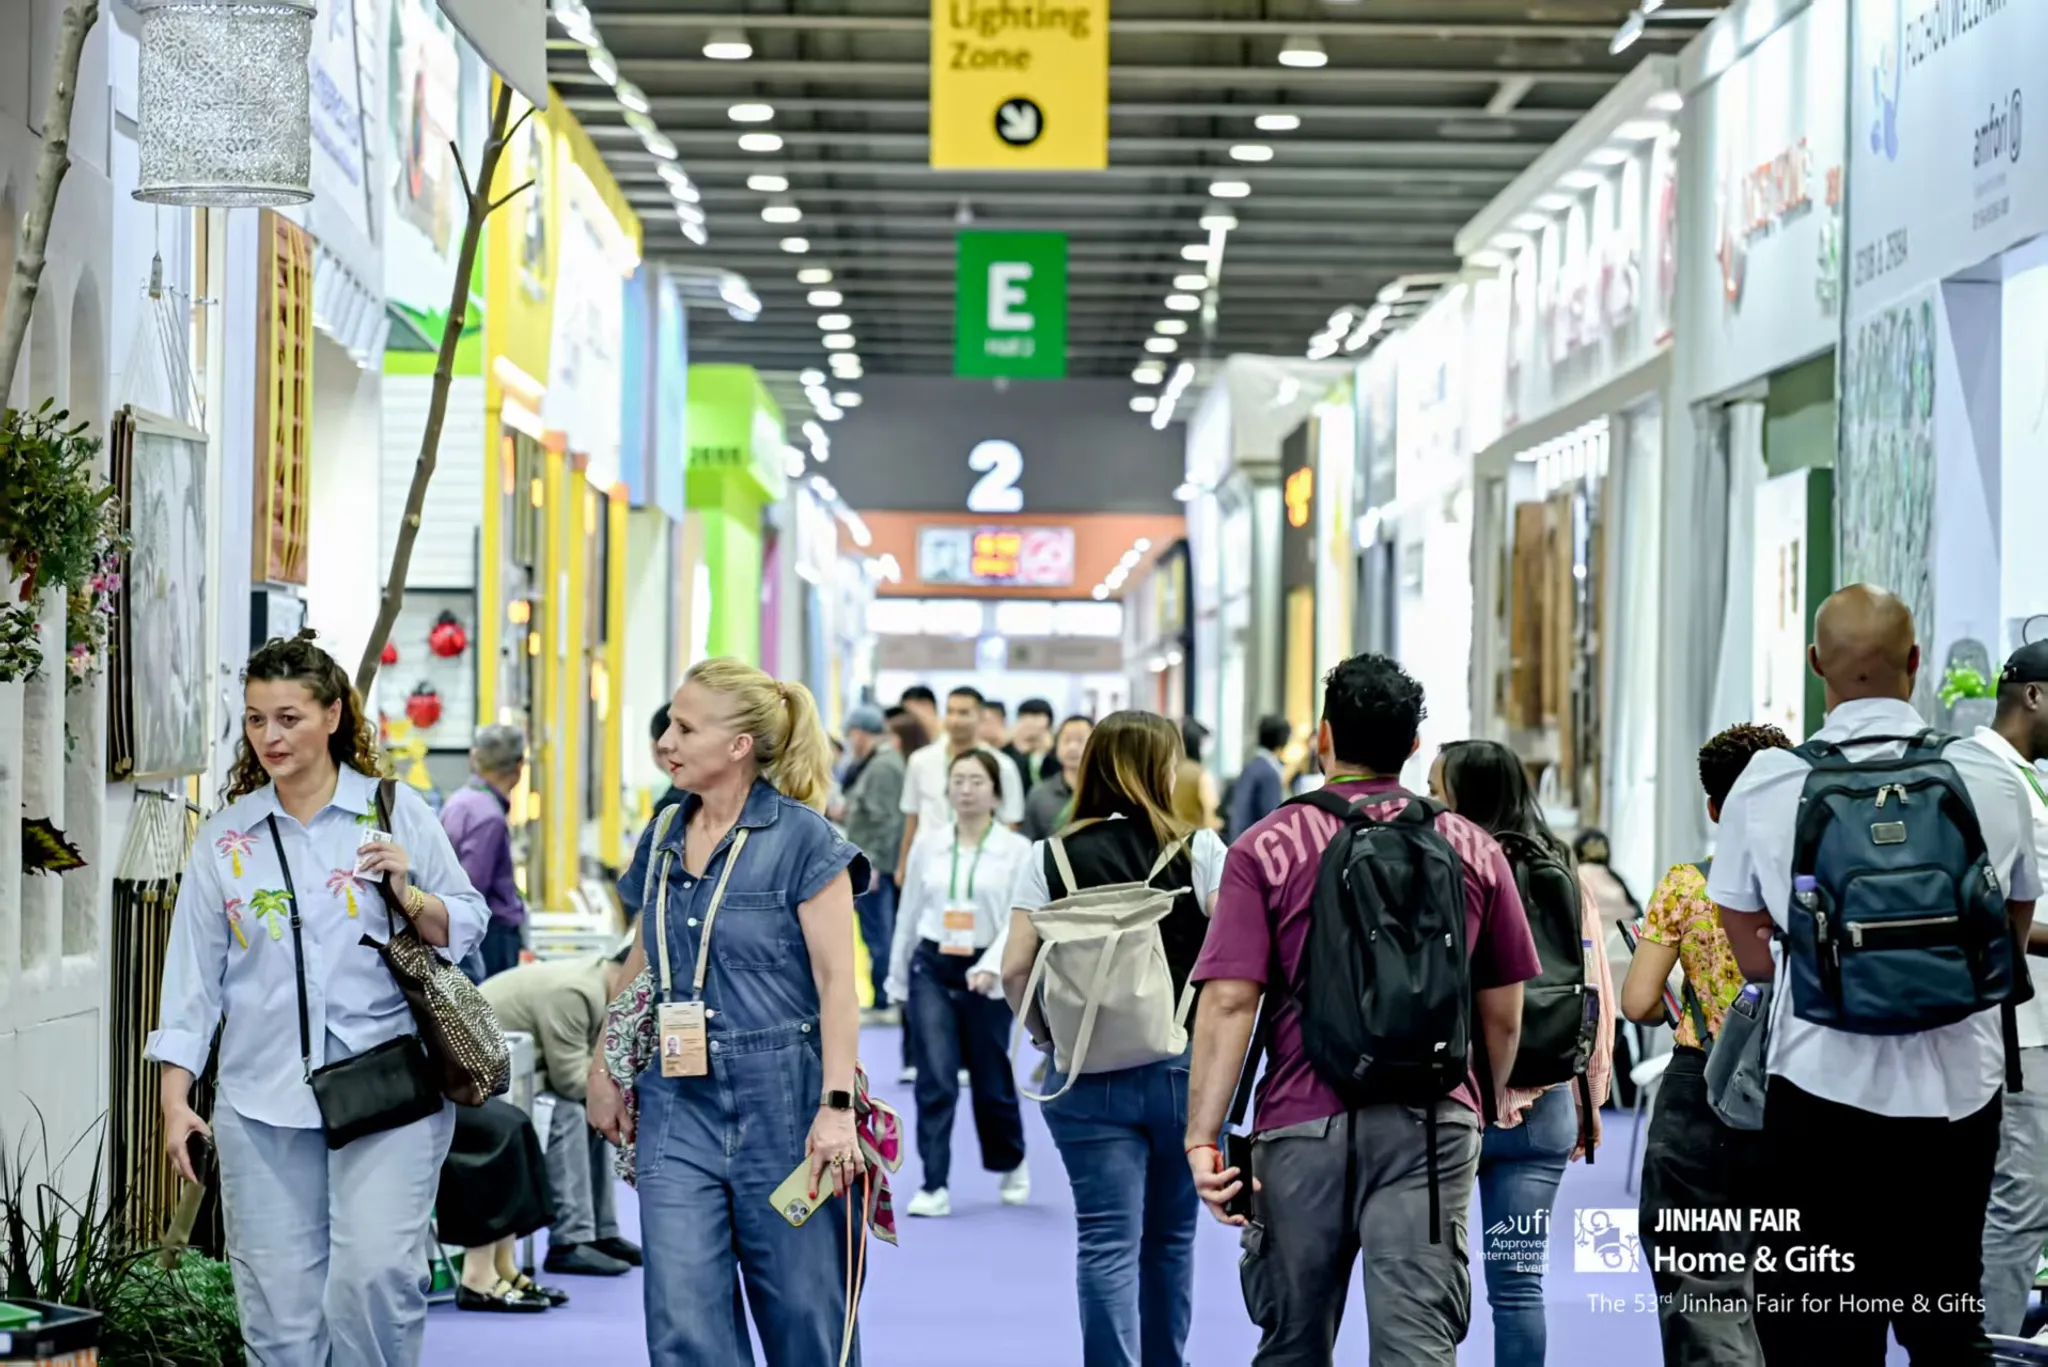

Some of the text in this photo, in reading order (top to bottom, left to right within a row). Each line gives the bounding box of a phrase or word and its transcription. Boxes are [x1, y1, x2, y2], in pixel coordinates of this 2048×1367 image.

[949, 0, 1091, 38] Lighting
[949, 42, 1032, 70] Zone
[987, 261, 1035, 331] E
[967, 439, 1024, 512] 2
[1254, 793, 1500, 886] GYMRK
